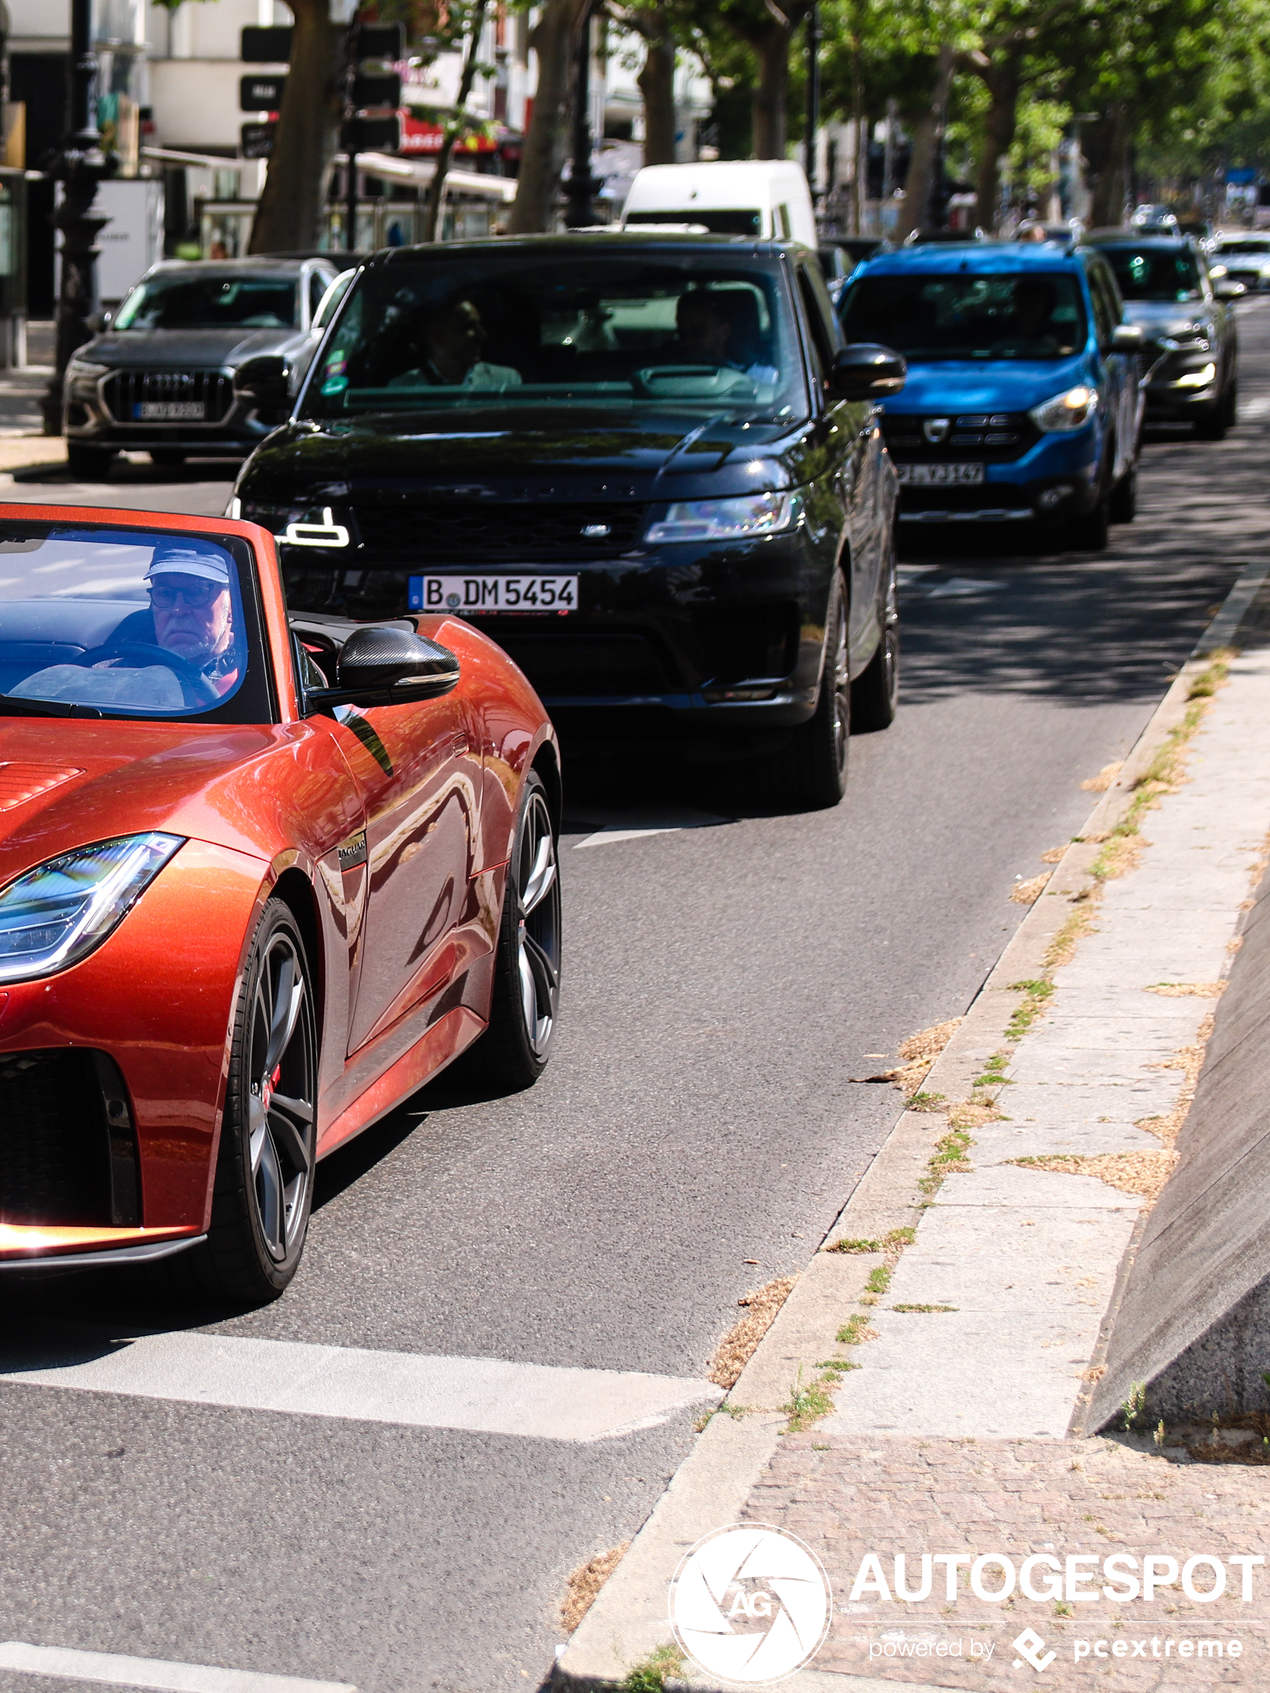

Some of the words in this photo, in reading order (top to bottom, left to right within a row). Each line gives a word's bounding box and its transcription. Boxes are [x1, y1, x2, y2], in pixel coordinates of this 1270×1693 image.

[427, 579, 443, 605] B
[464, 579, 498, 605] DM
[505, 579, 573, 606] 5454
[338, 840, 366, 858] JAGUAR
